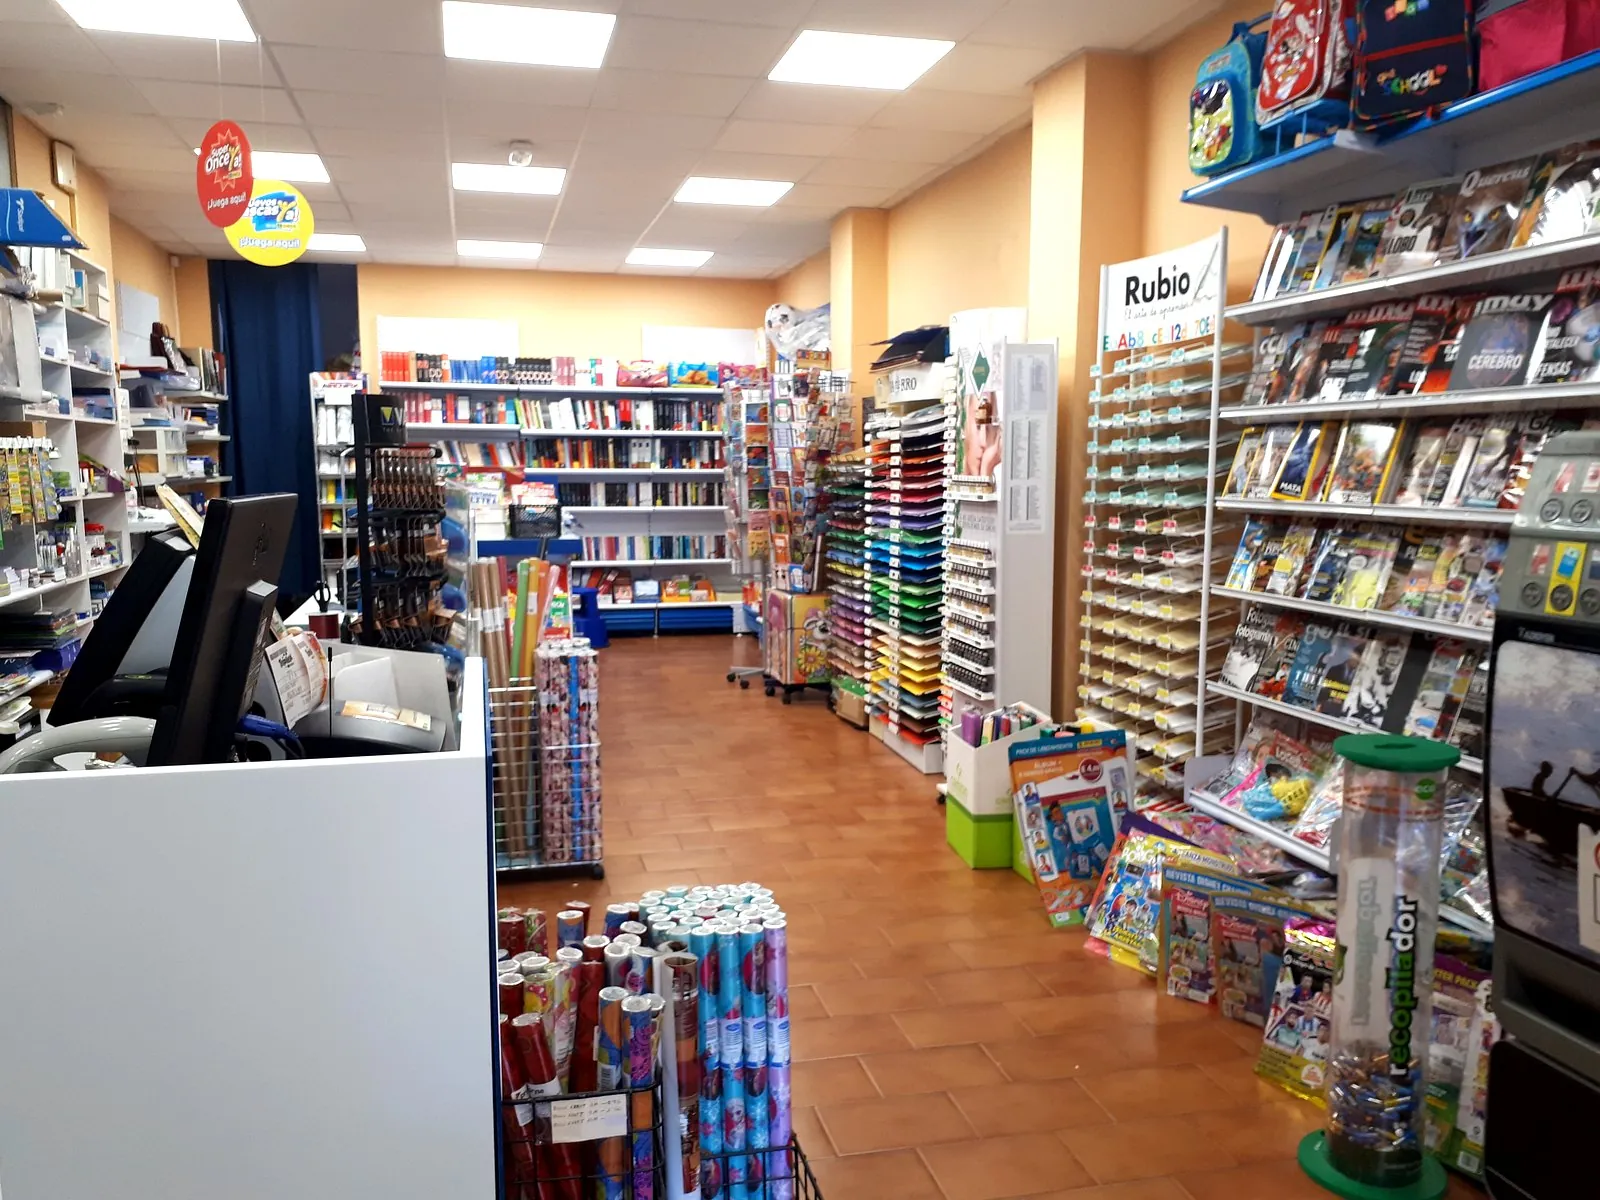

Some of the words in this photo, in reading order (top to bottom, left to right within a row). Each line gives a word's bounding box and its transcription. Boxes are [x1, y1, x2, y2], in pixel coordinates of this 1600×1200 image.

[1460, 166, 1532, 198] Quercus
[1125, 264, 1190, 307] Rubio
[1467, 353, 1524, 370] CEREBRO
[1386, 896, 1418, 1077] recopilador
